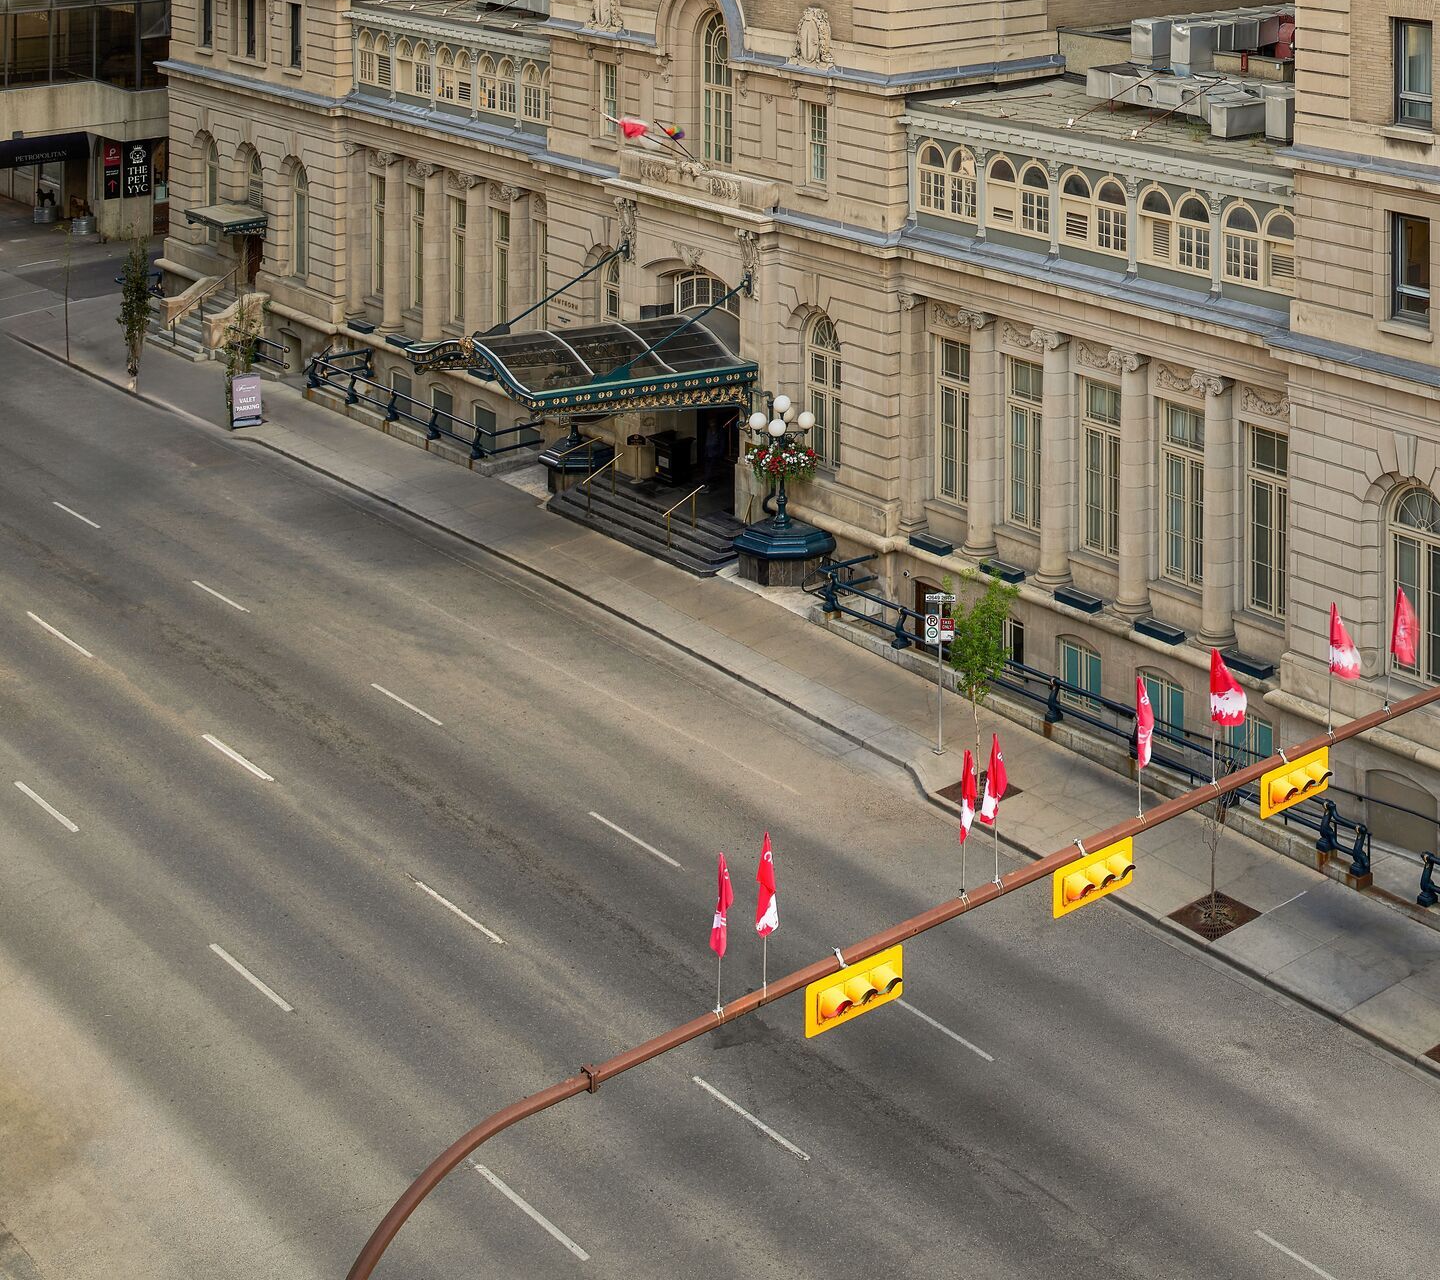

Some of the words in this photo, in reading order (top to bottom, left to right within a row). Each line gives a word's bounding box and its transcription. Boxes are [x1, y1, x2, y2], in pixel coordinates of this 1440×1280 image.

[15, 151, 67, 162] PETROPOLITAN
[127, 165, 148, 175] THE
[127, 175, 148, 185] PET
[127, 184, 149, 194] YYC
[239, 396, 256, 404] VALET
[235, 403, 260, 412] PARKING
